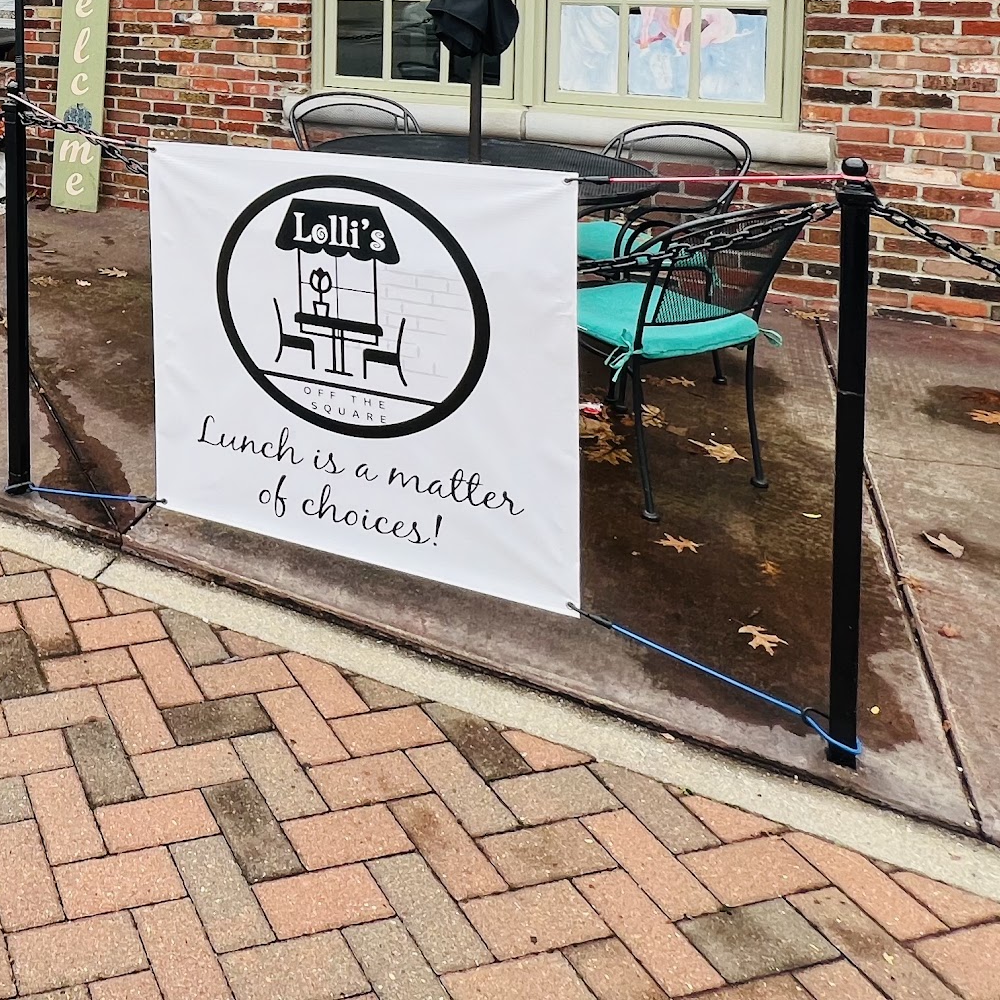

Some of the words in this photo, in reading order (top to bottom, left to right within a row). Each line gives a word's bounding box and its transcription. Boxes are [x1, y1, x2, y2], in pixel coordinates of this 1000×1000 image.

[293, 211, 386, 252] Lolli's
[303, 386, 336, 400] OFF
[351, 395, 386, 410] THE
[311, 401, 387, 424] SQUARE
[197, 415, 304, 466] Lunch
[314, 448, 345, 475] is
[355, 461, 378, 482] a
[389, 468, 526, 516] matter
[258, 474, 288, 518] of
[302, 483, 444, 546] choices!
